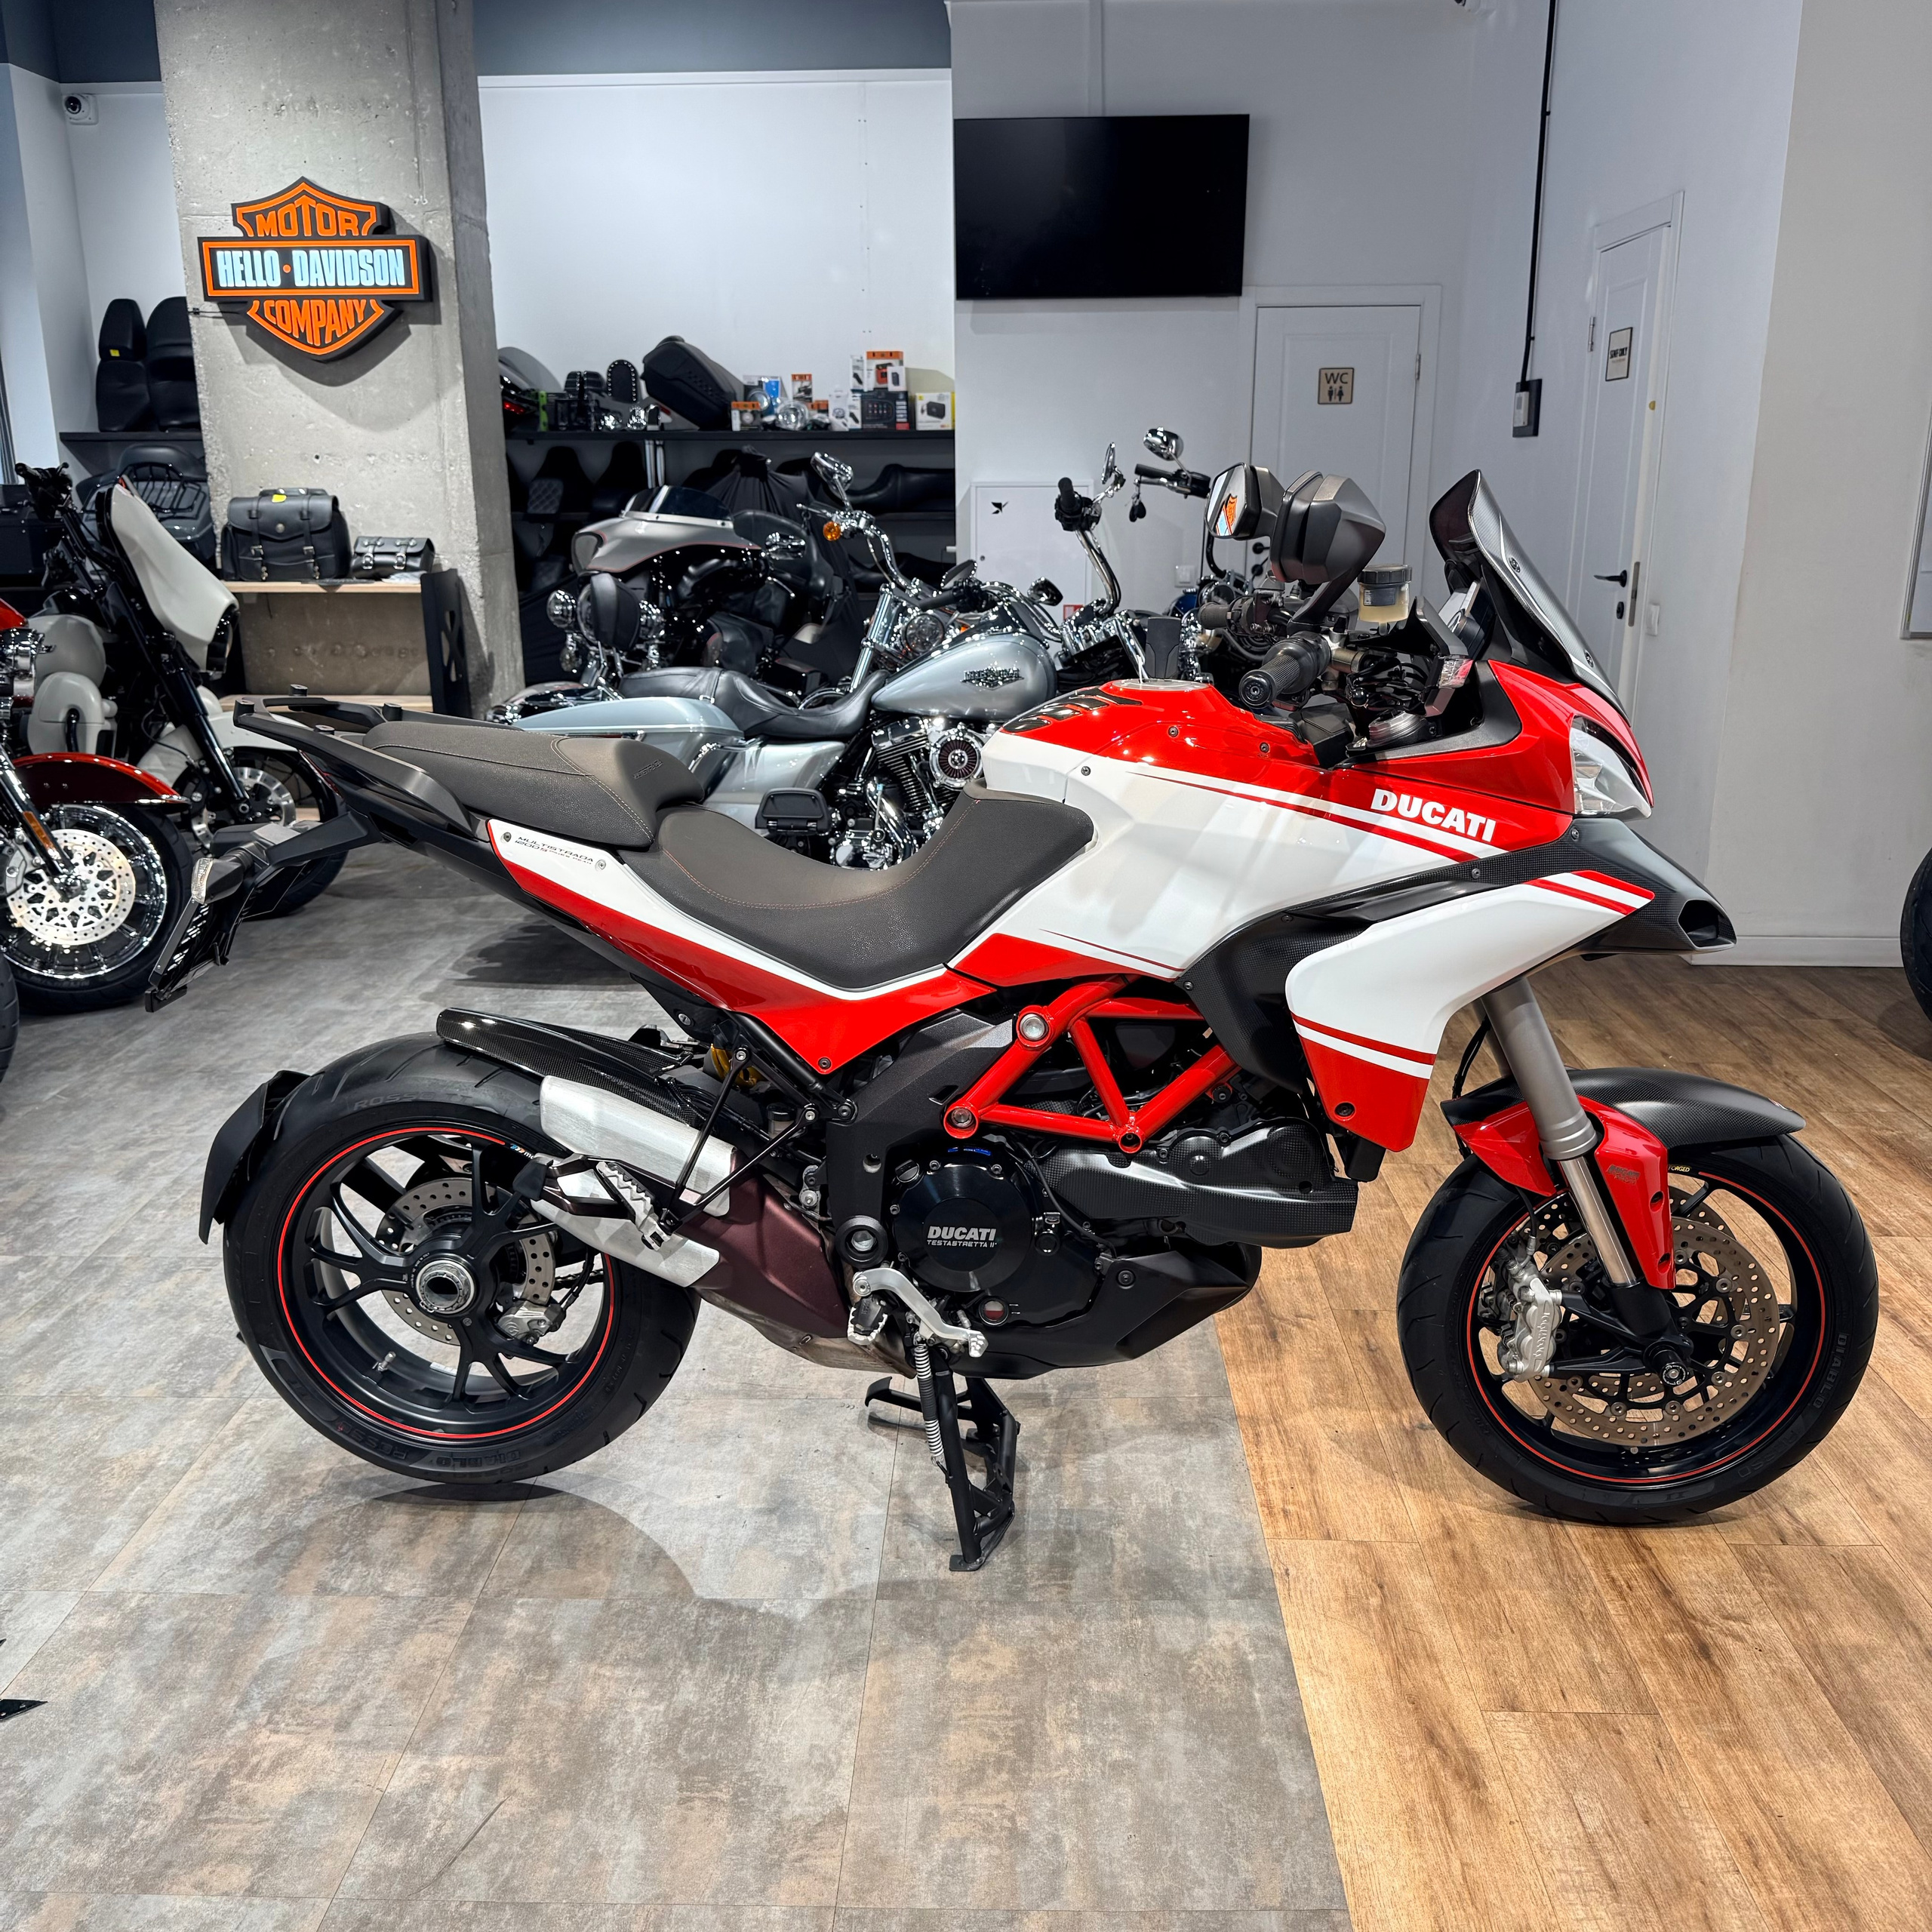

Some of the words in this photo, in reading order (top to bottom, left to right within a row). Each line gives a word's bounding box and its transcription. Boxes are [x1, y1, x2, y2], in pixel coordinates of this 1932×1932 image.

[255, 194, 359, 237] MOTOR
[216, 250, 281, 288] HELLO
[291, 249, 405, 286] DAVIDSON
[263, 299, 367, 346] COMPANY
[1324, 372, 1349, 384] WC
[1371, 788, 1497, 842] DUCATI
[518, 836, 594, 863] MULTISTRADA
[927, 1226, 997, 1241] DUCATI
[927, 1239, 988, 1247] TESTASTRETTA
[1813, 1333, 1848, 1409] DIABLO
